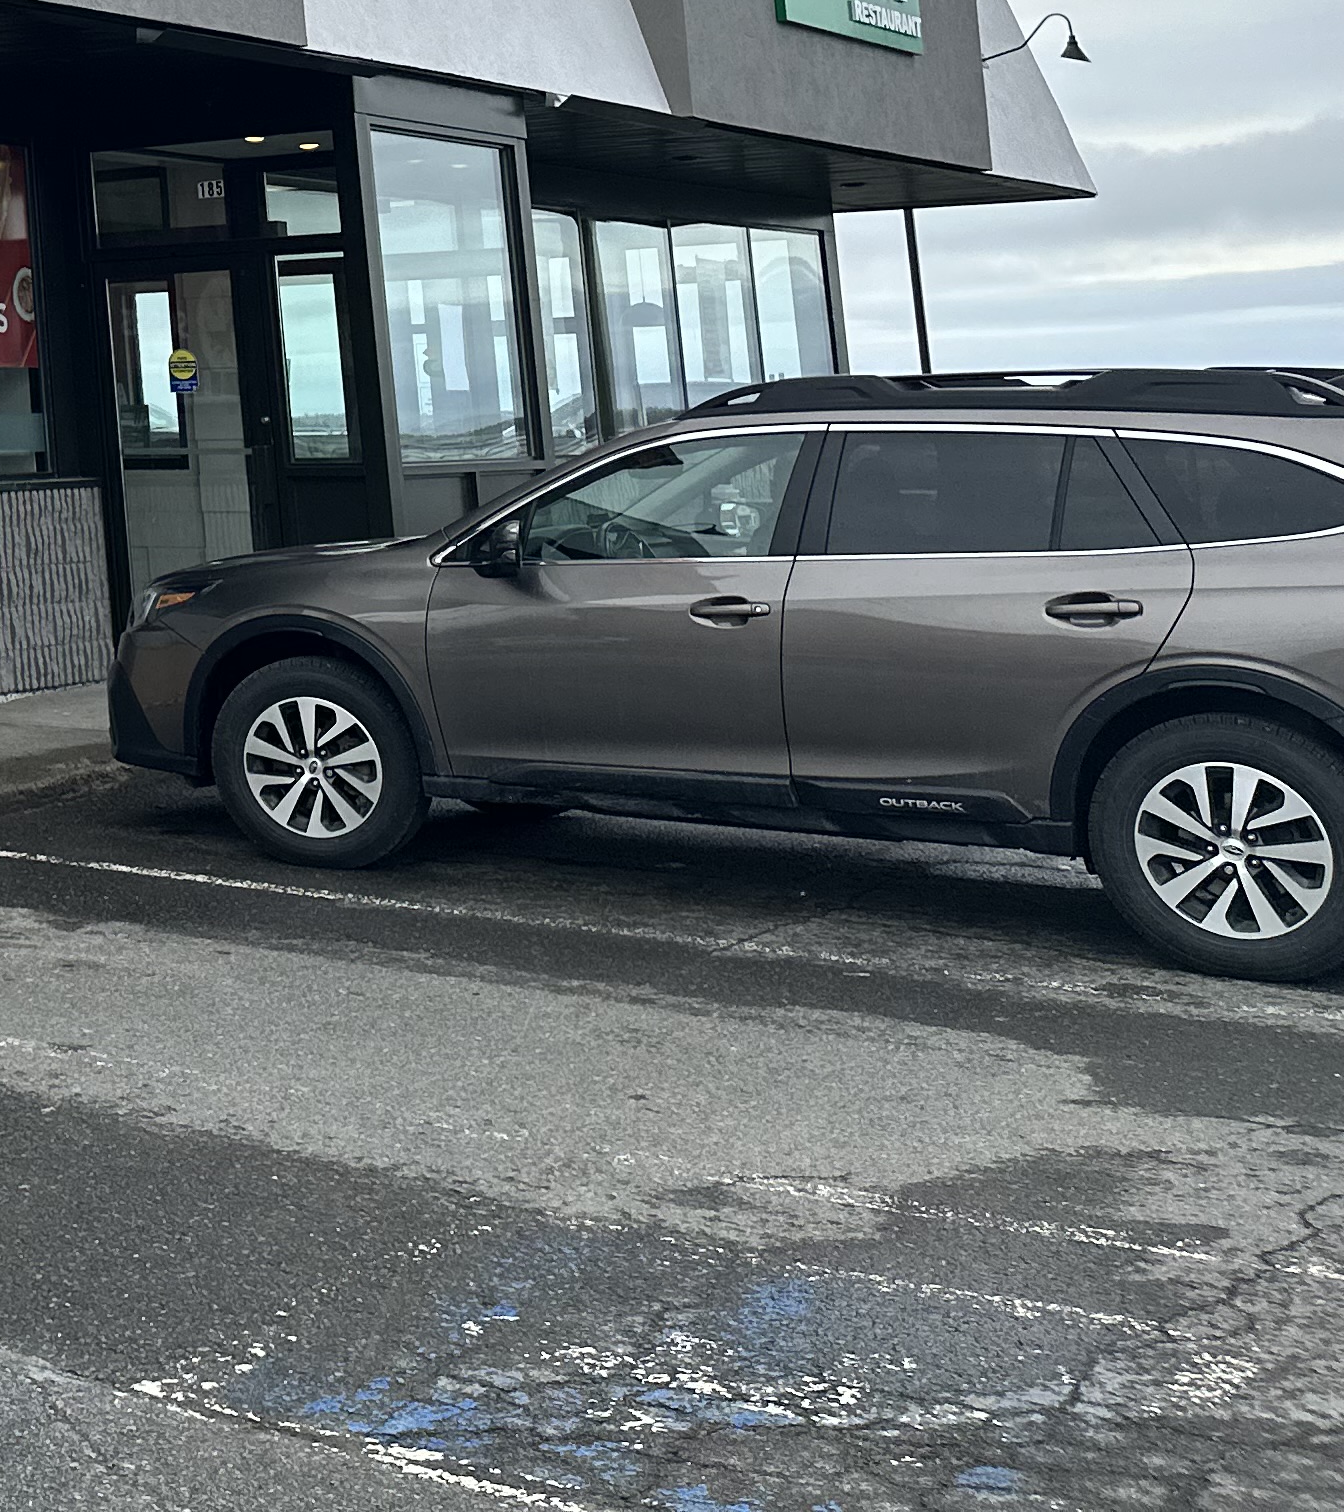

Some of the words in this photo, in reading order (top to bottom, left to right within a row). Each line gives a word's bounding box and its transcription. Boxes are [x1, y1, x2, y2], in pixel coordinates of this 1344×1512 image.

[853, 0, 922, 38] RESTAURANT
[199, 180, 223, 198] 185
[879, 797, 968, 814] OUTBACK
